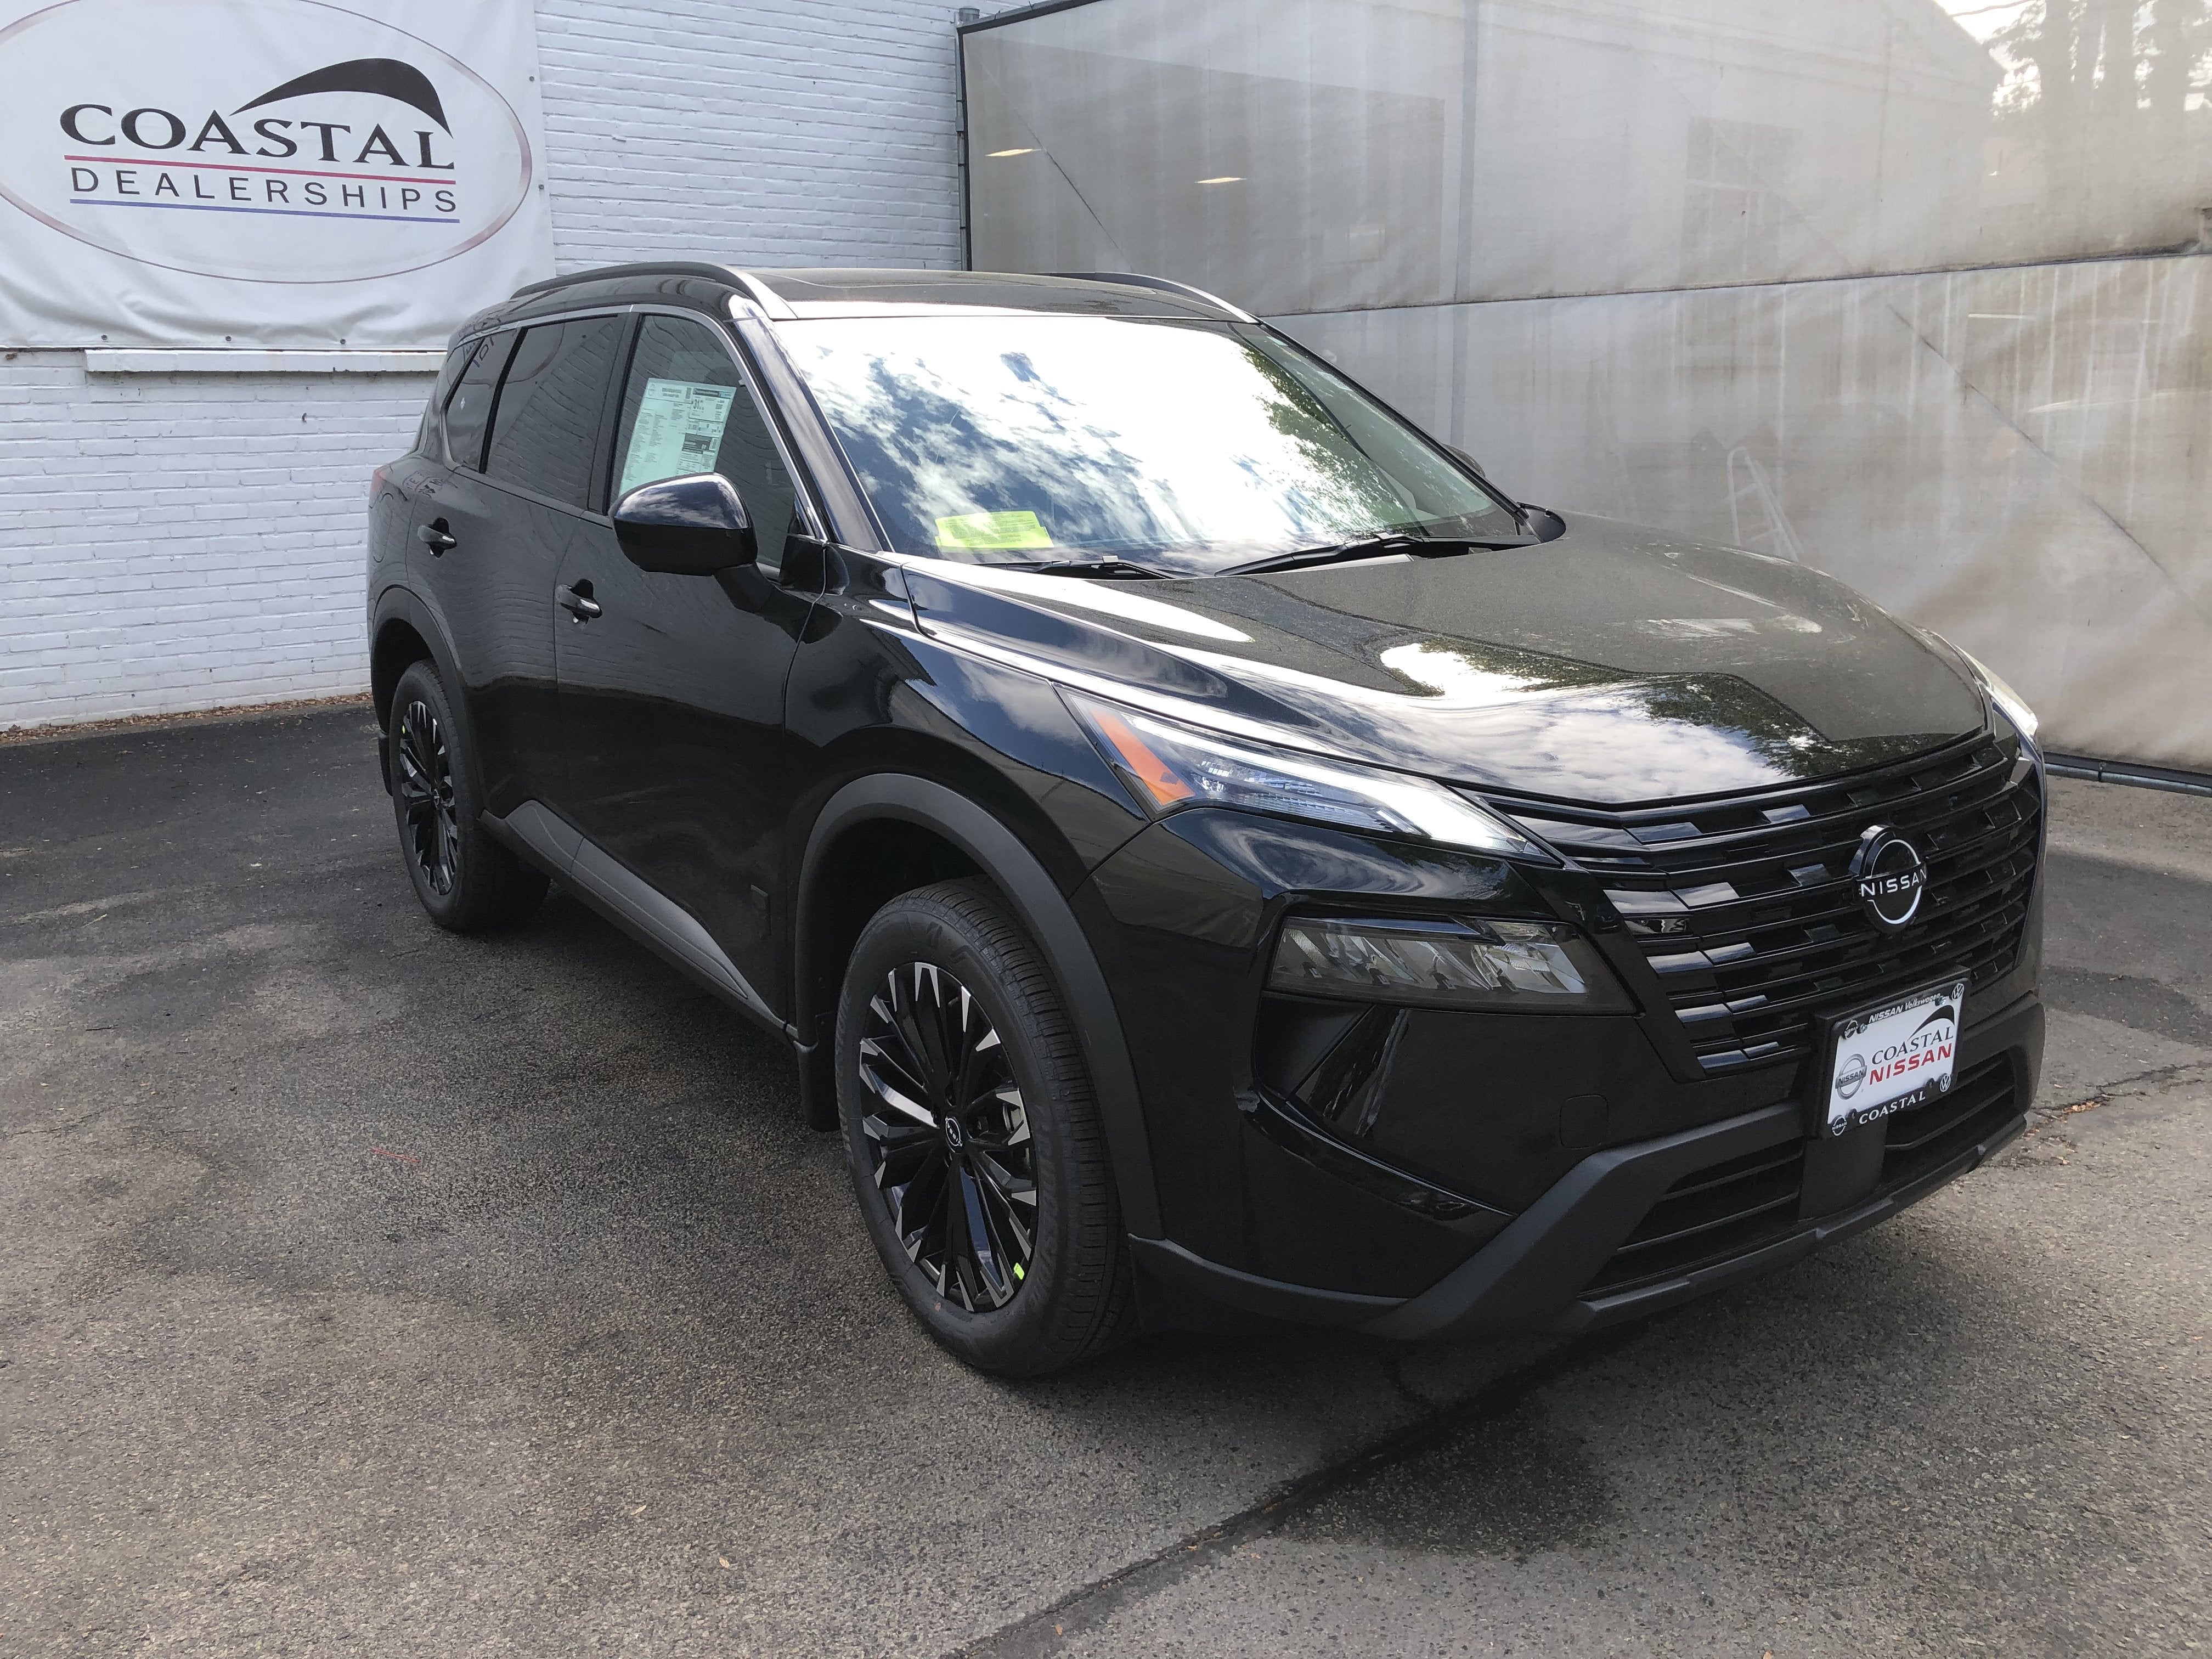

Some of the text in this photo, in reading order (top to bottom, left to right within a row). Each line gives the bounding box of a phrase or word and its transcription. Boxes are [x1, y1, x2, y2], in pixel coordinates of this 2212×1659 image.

[60, 103, 455, 170] COASTAL
[70, 167, 457, 213] DEALERSHIPS
[1860, 868, 1927, 897] NISSAN
[1868, 992, 1941, 1024] NISSAN Volkswagen
[1869, 1042, 1953, 1086] NISSAN
[1872, 1026, 1954, 1065] COASTAL
[1838, 1069, 1865, 1085] NISSAN
[1859, 1090, 1926, 1125] COASTAL
